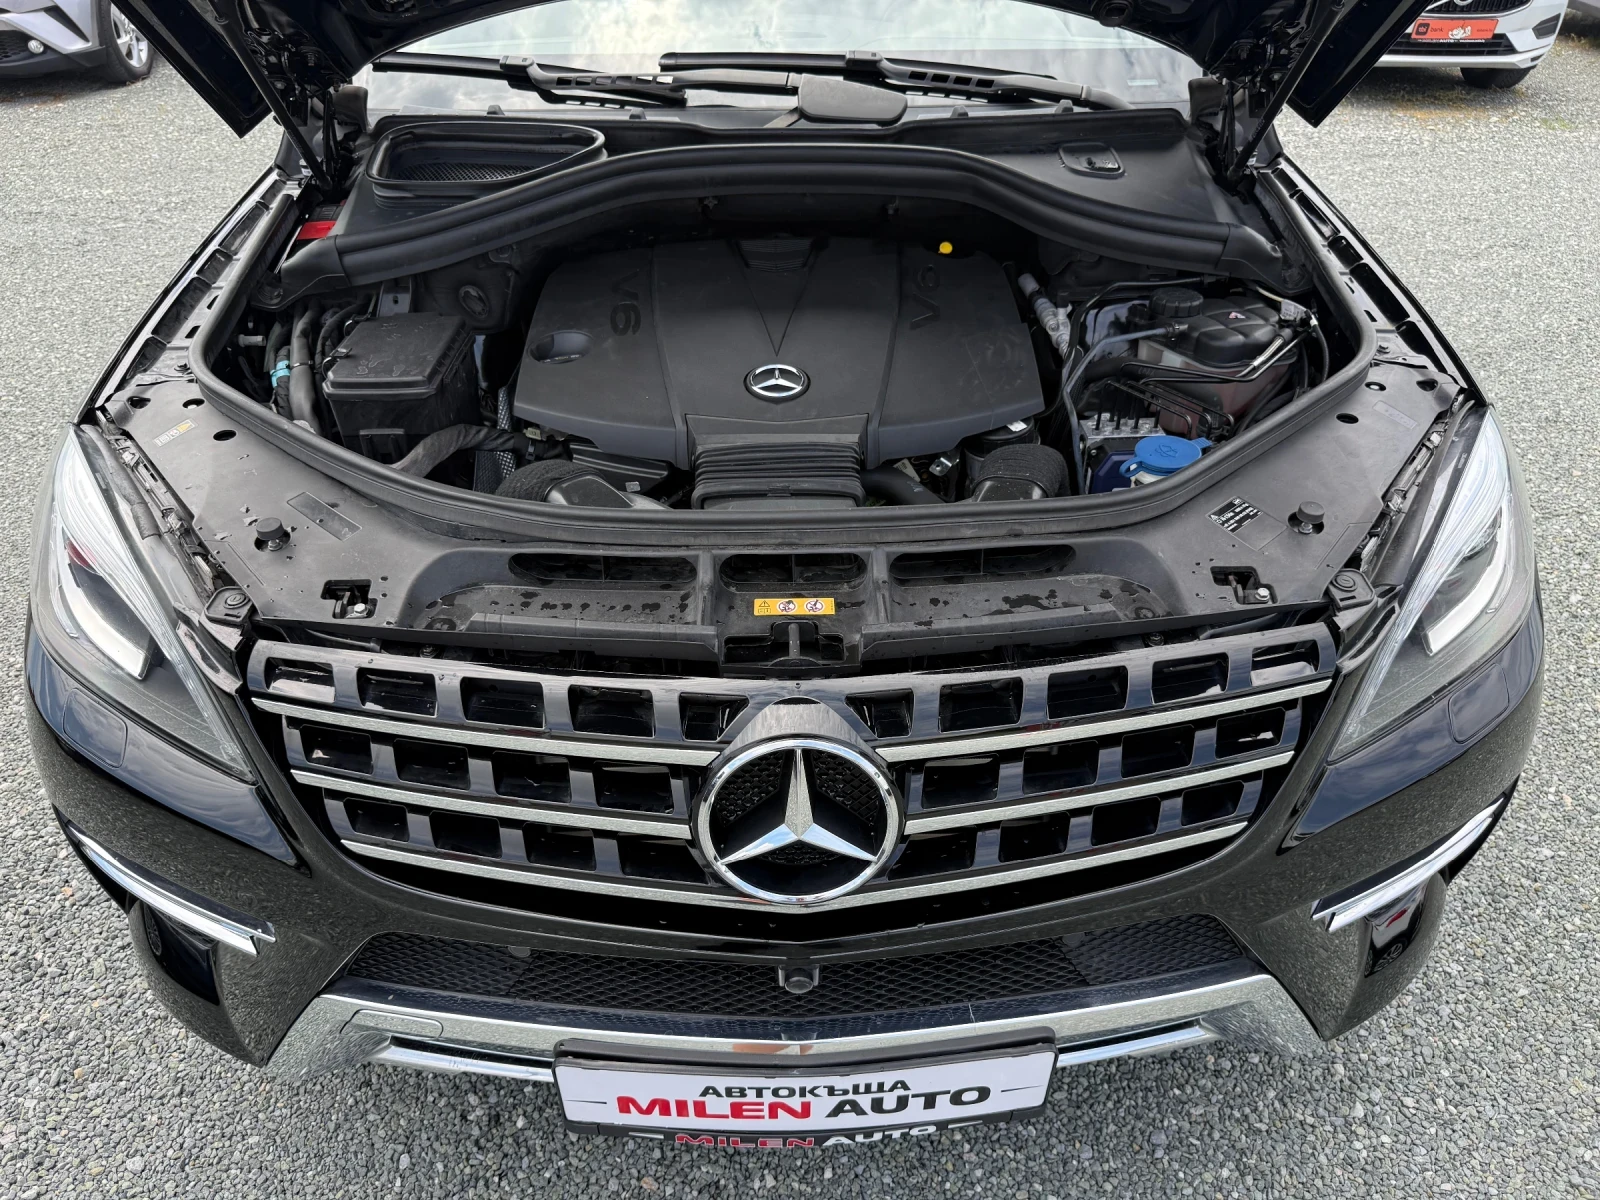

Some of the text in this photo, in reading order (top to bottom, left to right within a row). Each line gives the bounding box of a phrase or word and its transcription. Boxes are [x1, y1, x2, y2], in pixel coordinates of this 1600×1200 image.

[610, 270, 641, 337] V6
[616, 1086, 991, 1120] MILEN AUTO
[675, 1125, 937, 1149] MILEN AUTO
